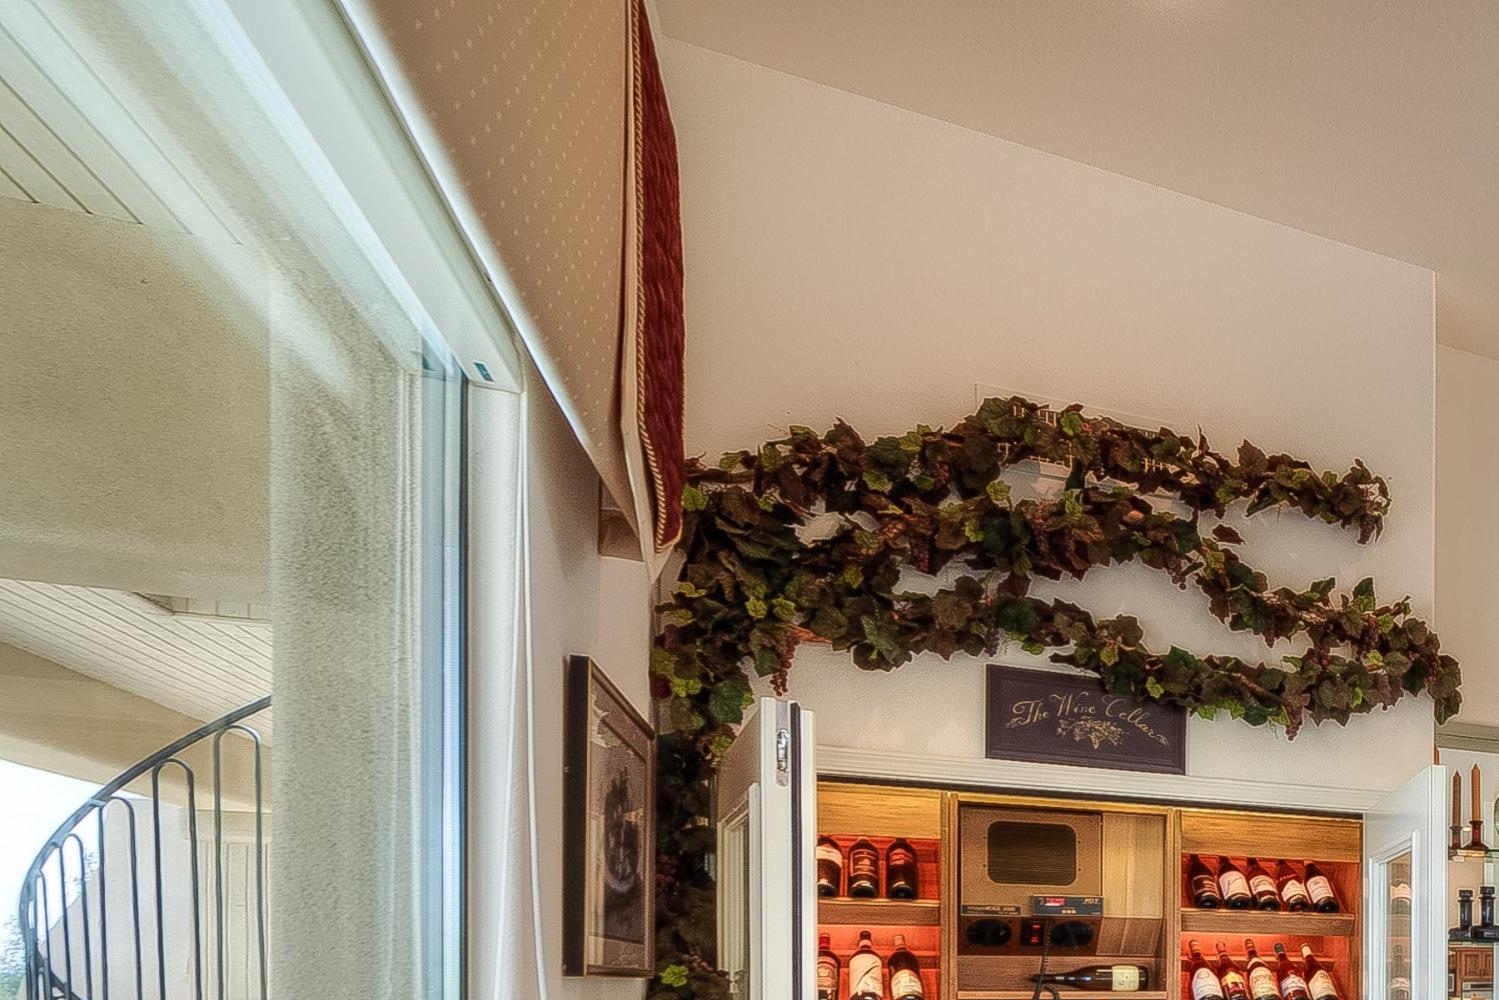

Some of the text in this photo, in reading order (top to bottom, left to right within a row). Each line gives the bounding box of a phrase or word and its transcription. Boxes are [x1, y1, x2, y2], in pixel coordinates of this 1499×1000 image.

[1011, 691, 1158, 739] The Wine Cellar
